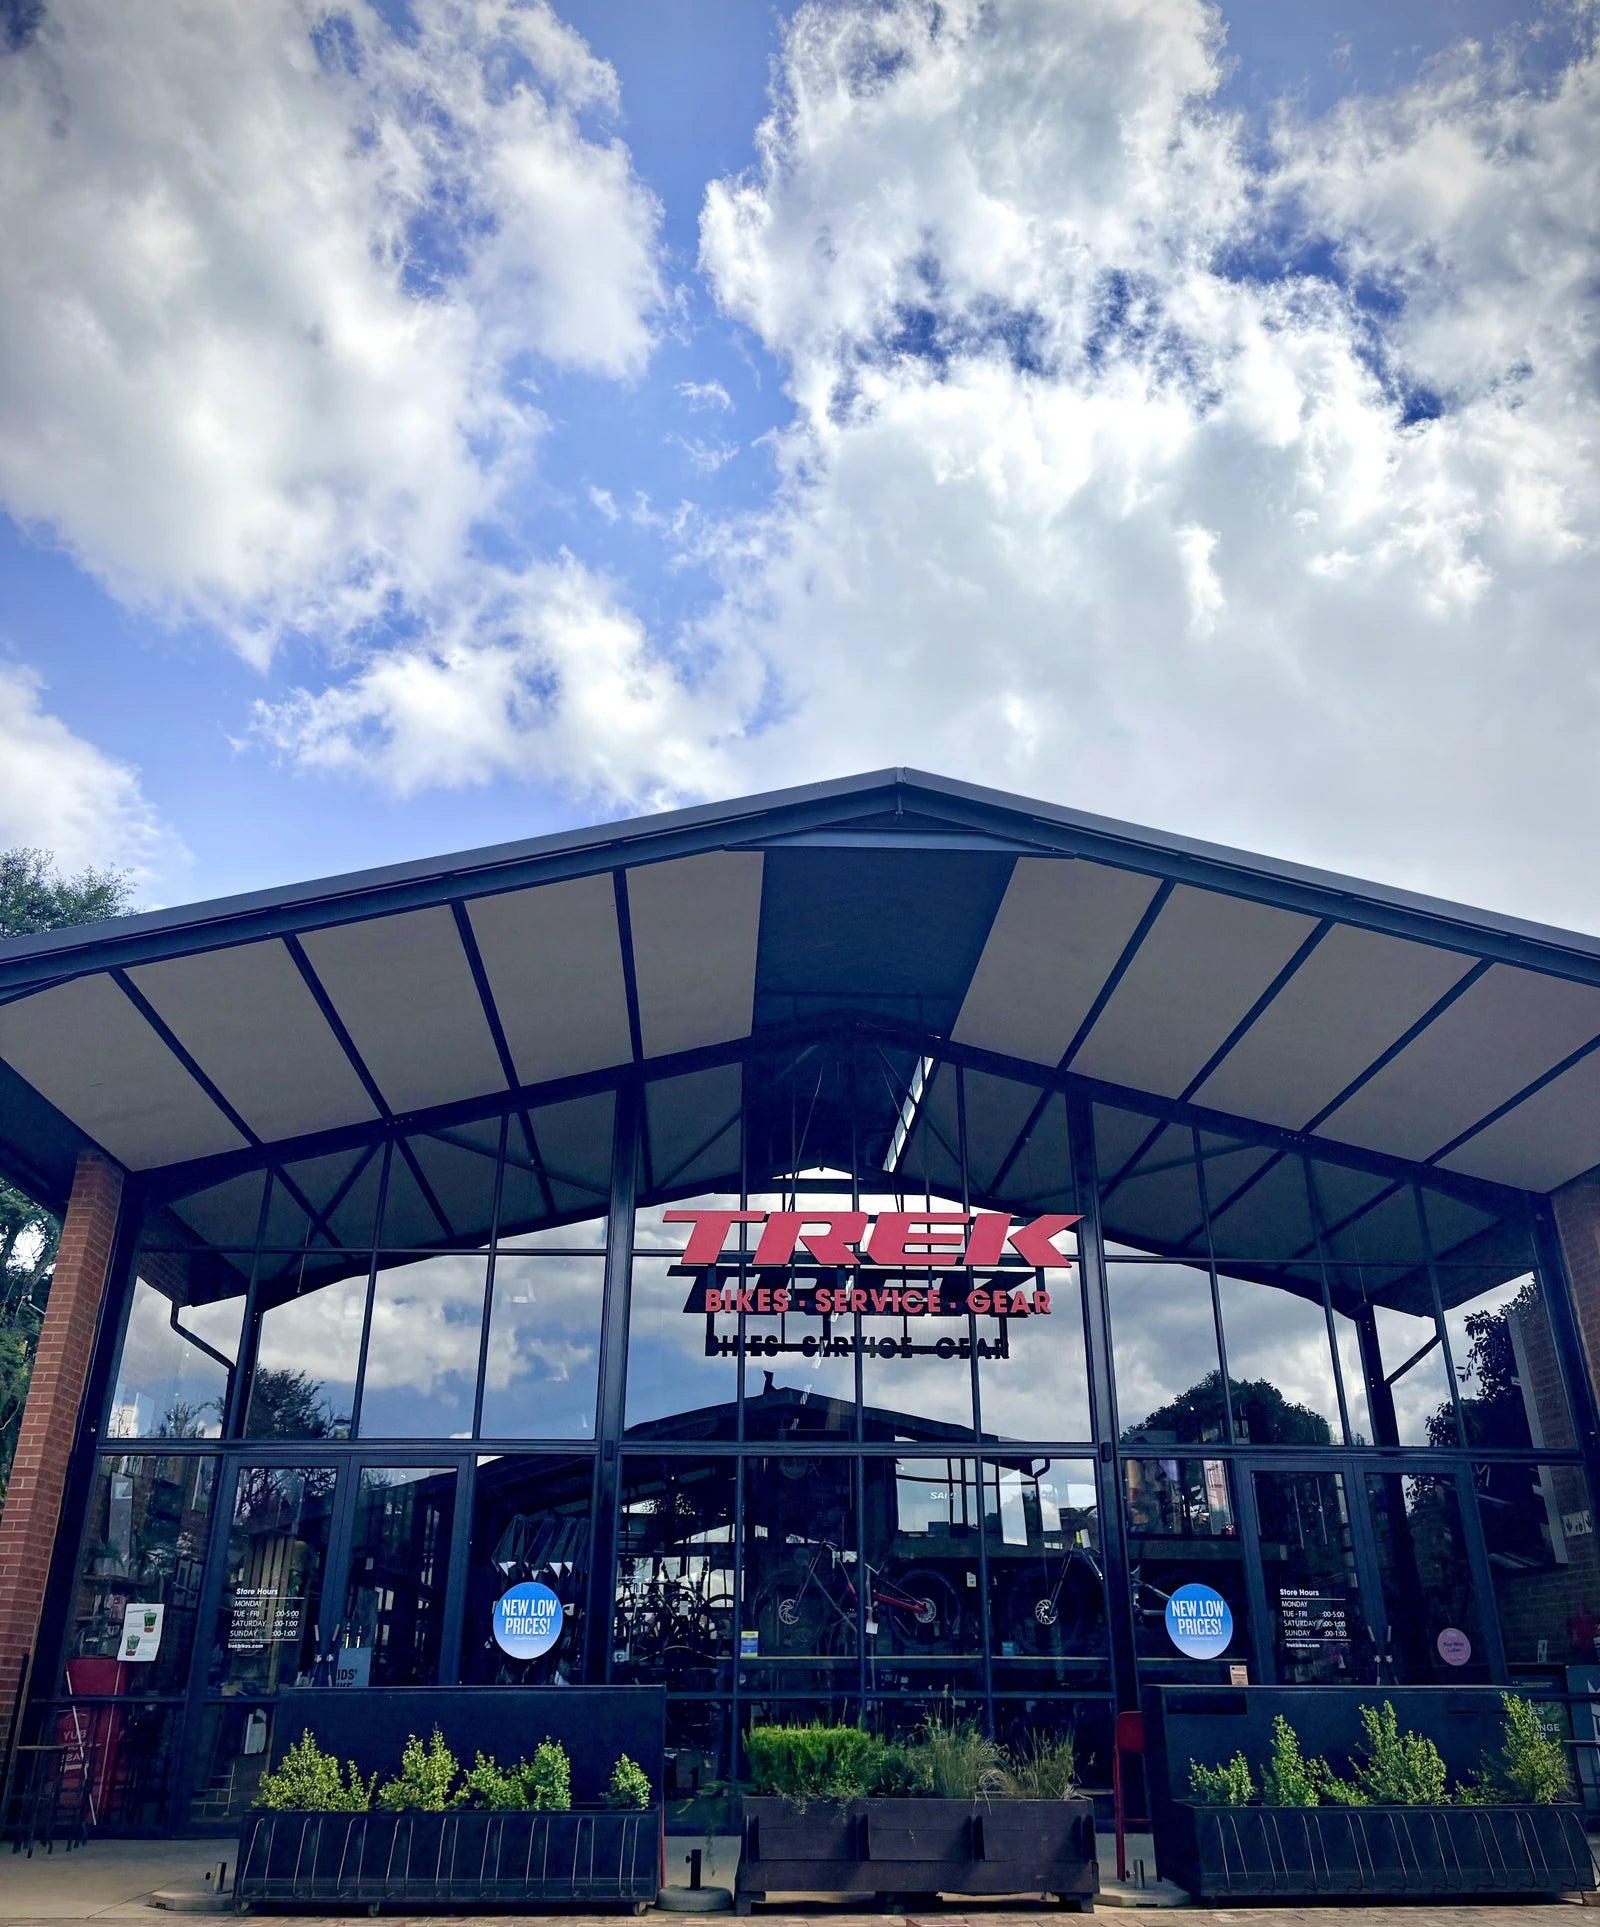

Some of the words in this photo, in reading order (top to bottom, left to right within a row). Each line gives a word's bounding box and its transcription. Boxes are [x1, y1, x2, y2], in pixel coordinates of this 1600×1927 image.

[662, 1210, 1085, 1268] TREK
[705, 1288, 789, 1313] BIKES
[815, 1288, 941, 1314] SERVICE
[966, 1289, 1051, 1314] GEAR
[1279, 1588, 1298, 1596] Store
[501, 1599, 529, 1616] NEW
[530, 1599, 557, 1617] LOW
[1171, 1600, 1197, 1617] NEW
[1199, 1600, 1224, 1617] LOW
[504, 1617, 551, 1635] PRICES!
[1177, 1618, 1223, 1635] PRICES!
[1284, 1629, 1311, 1637] SUNDAY
[337, 1669, 357, 1680] IDS'
